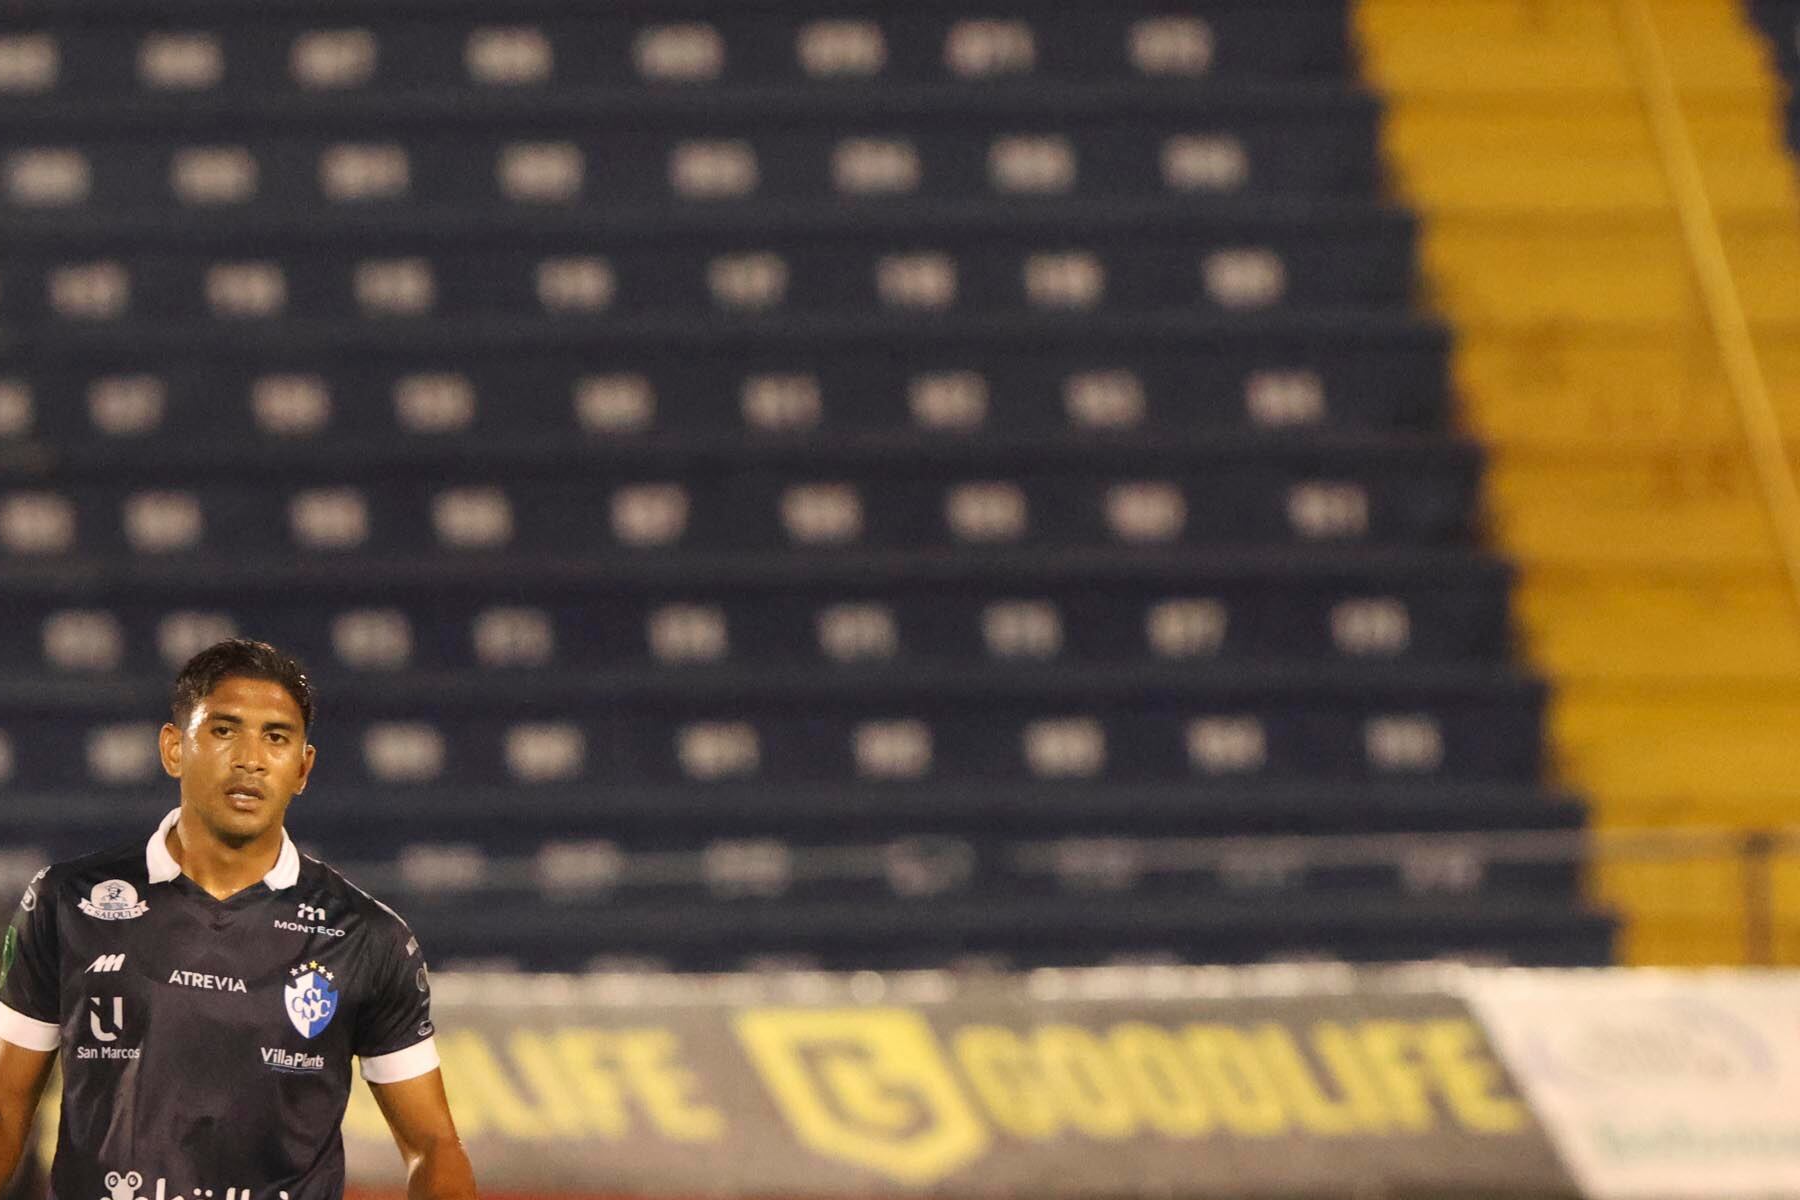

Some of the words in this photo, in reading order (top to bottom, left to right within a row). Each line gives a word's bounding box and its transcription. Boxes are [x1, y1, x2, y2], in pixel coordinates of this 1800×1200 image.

[273, 919, 346, 938] MONTECO
[168, 969, 247, 993] ATREVIA
[76, 1046, 98, 1059] San
[101, 1046, 140, 1060] Marcos
[953, 1020, 1526, 1139] GOODLIFE
